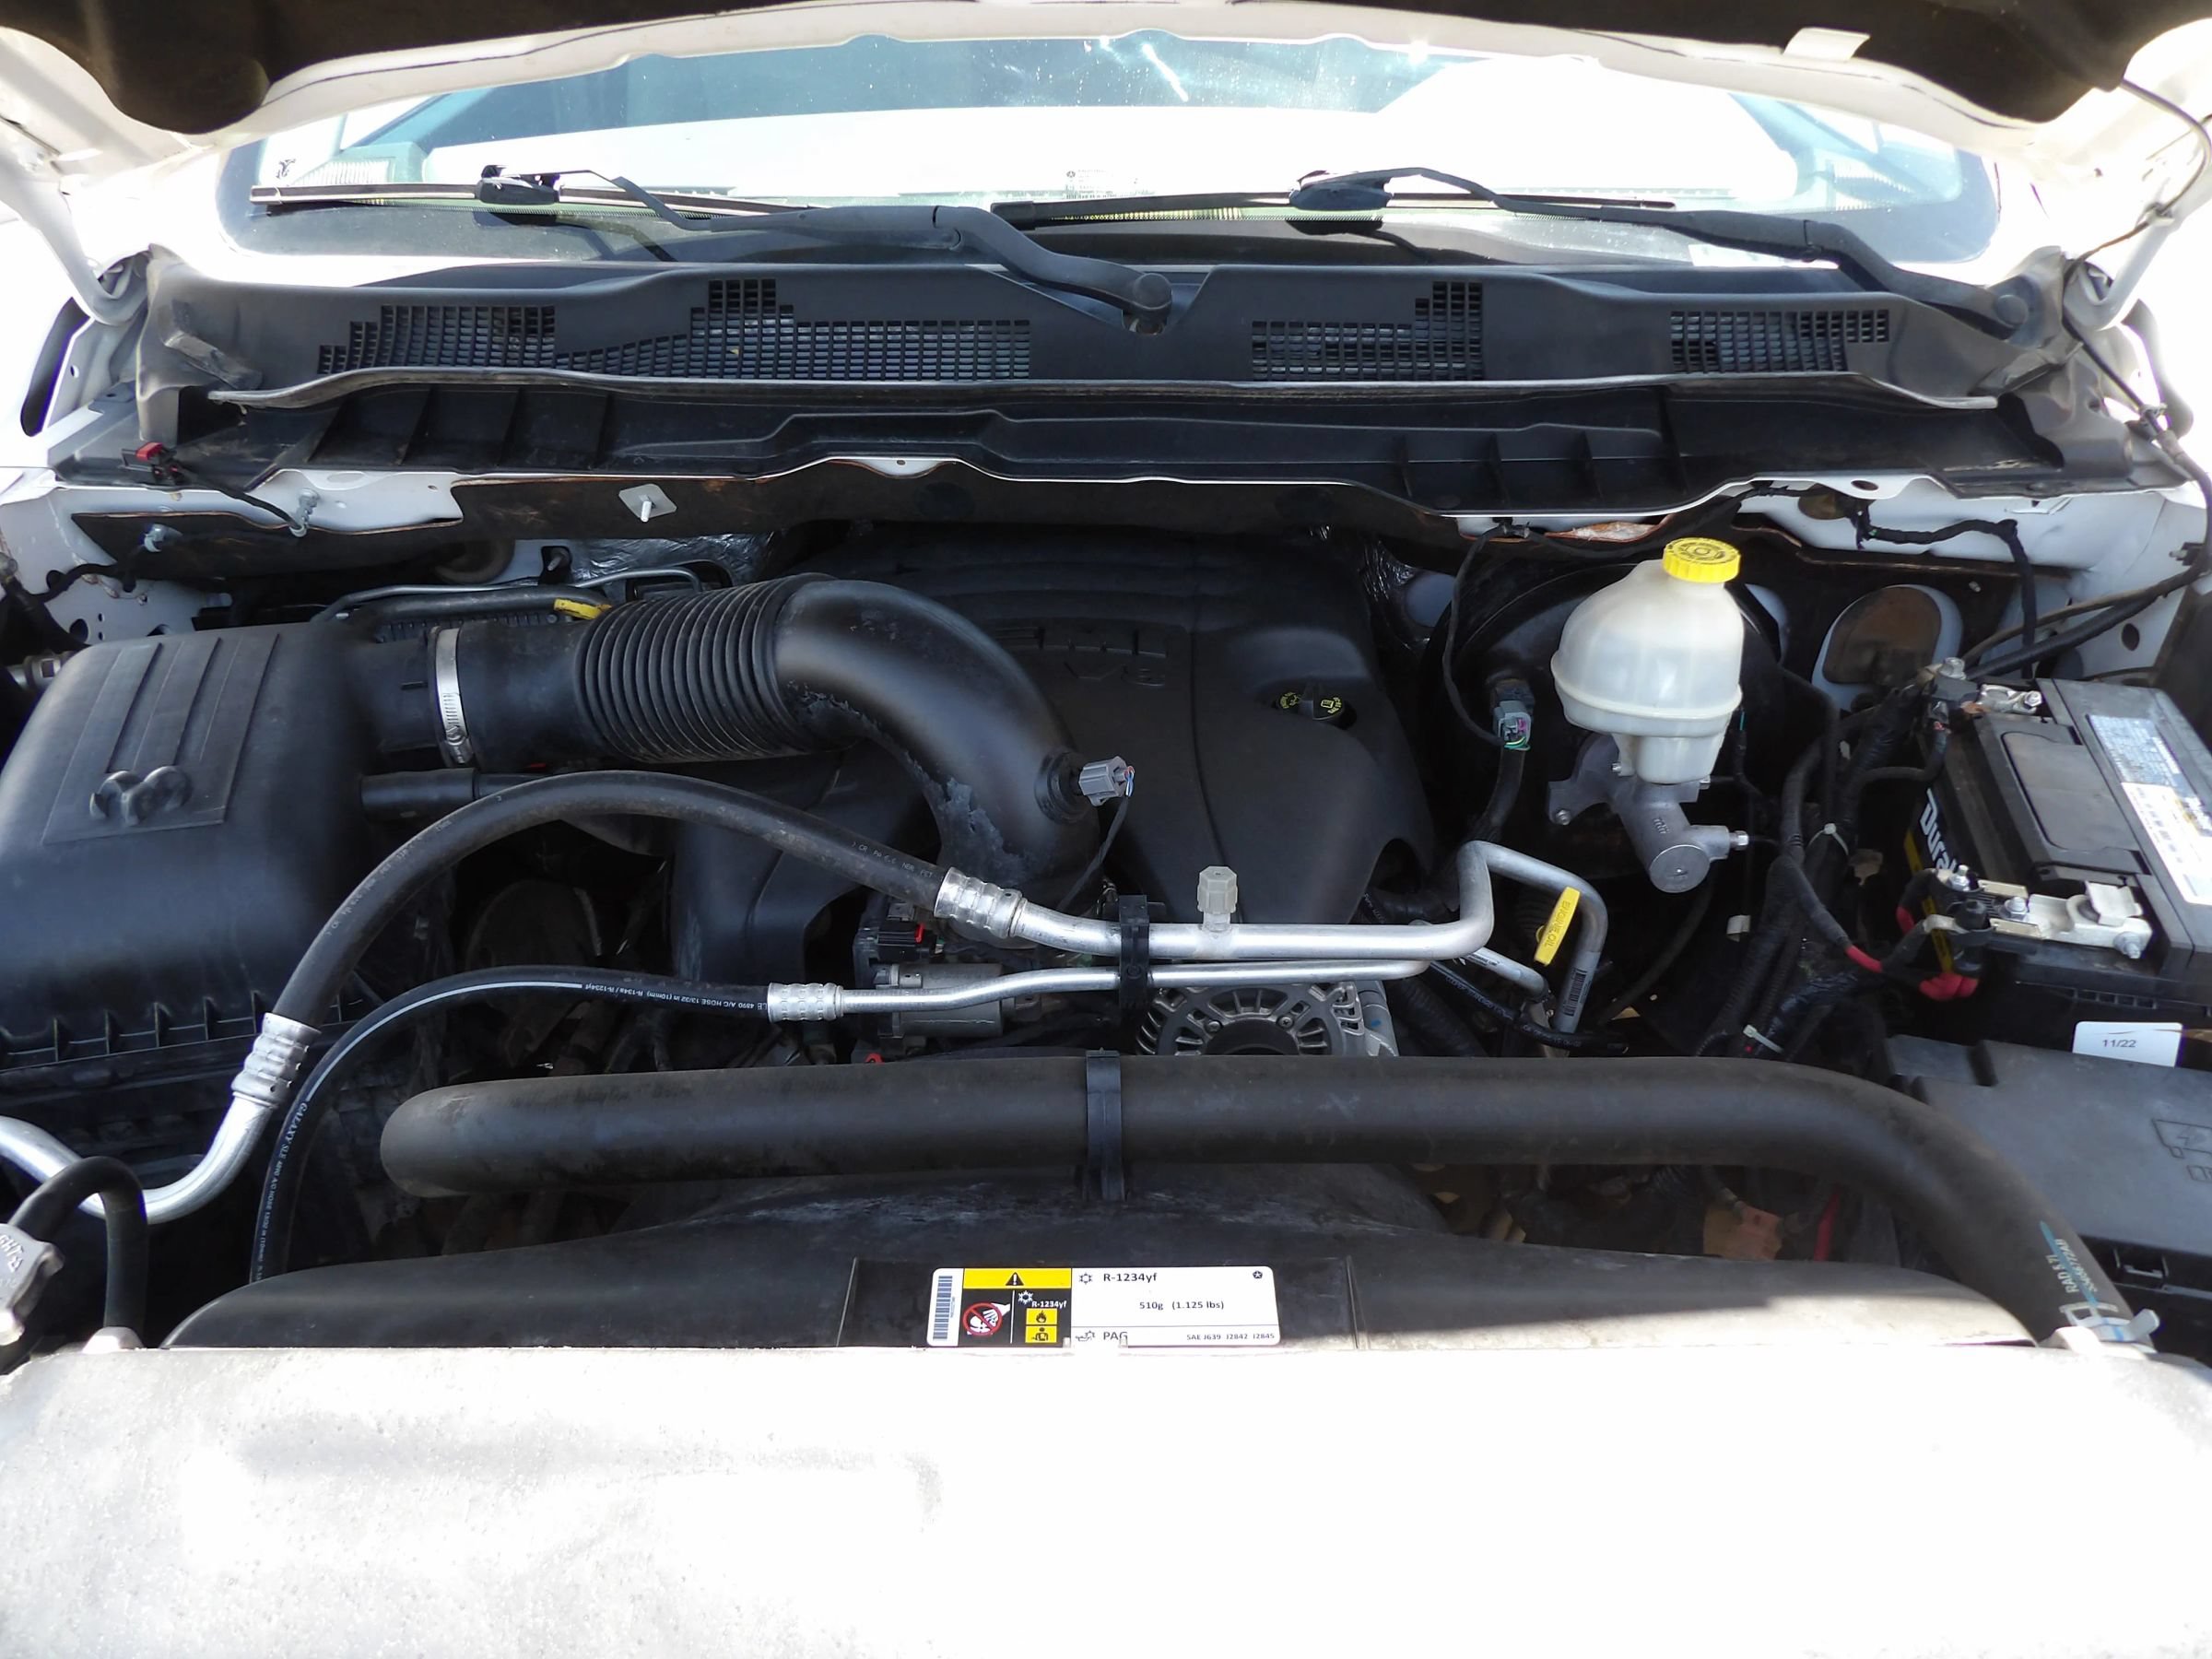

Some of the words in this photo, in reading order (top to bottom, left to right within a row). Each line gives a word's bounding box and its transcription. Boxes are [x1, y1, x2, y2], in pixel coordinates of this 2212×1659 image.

[585, 983, 615, 993] R-1234yf
[619, 987, 643, 996] R-134a
[646, 990, 673, 1001] (10mm)
[680, 995, 700, 1004] 13/32
[701, 998, 722, 1006] HOSE
[2102, 1039, 2137, 1048] 11/22
[286, 1102, 308, 1145] GALAXY
[1103, 1273, 1158, 1283] R-1234yf
[2058, 1272, 2079, 1293] RAD
[1031, 1300, 1067, 1309] R-1234yf
[1139, 1301, 1164, 1311] 510g
[1171, 1300, 1204, 1310] (1.125
[1206, 1300, 1225, 1310] lbs)
